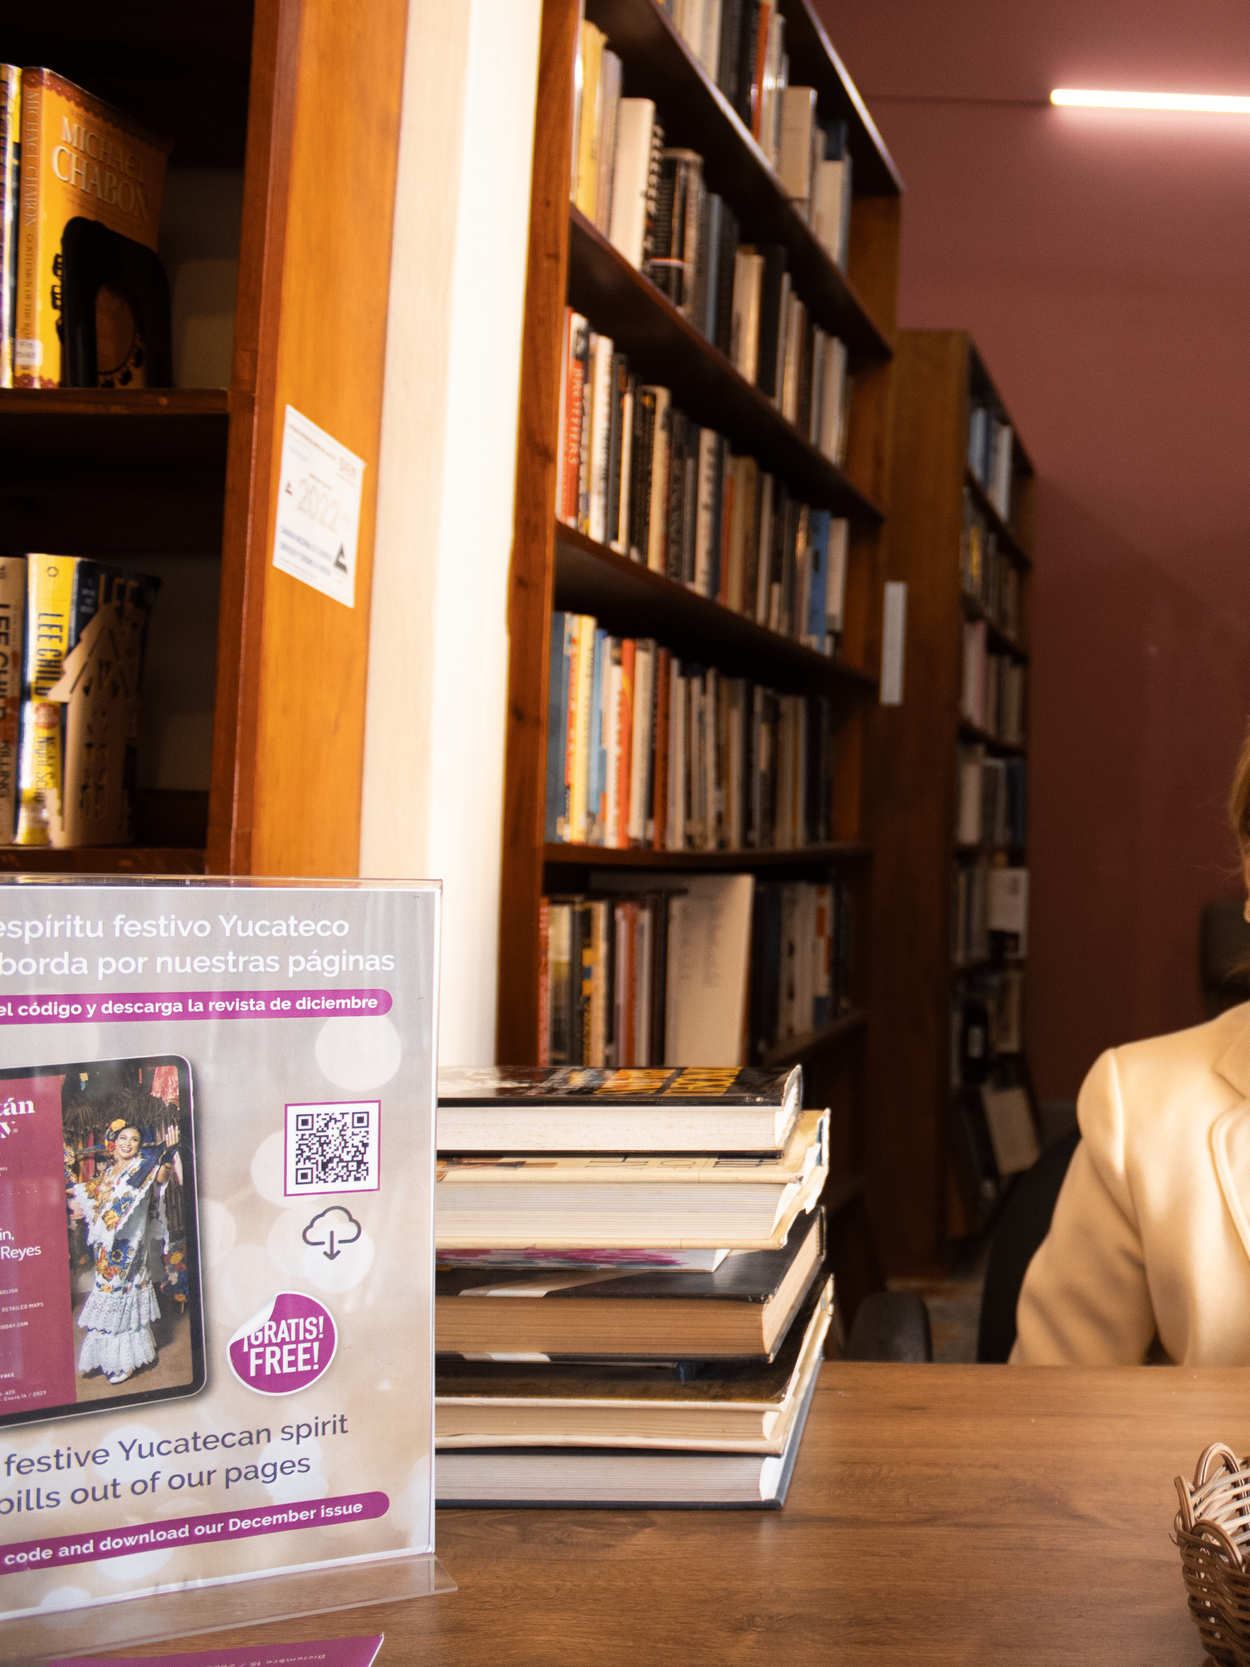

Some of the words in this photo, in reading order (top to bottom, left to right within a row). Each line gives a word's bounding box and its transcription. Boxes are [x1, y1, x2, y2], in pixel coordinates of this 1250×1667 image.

[24, 165, 38, 227] CHABON
[37, 612, 64, 644] LEE
[35, 648, 61, 697] CHILD
[113, 914, 212, 938] festivo
[218, 914, 350, 938] Yucateco
[98, 955, 148, 980] por
[155, 951, 280, 974] nuestras
[288, 949, 395, 977] páginas
[17, 1000, 82, 1019] código
[86, 1003, 97, 1018] y
[101, 998, 183, 1017] descarga
[188, 998, 204, 1013] la
[208, 996, 266, 1012] revista
[269, 996, 291, 1011] de
[295, 994, 378, 1010] diciembre
[1, 1245, 42, 1262] Reyes
[1, 1303, 29, 1313] DETAILED
[249, 1341, 320, 1377] FREE!
[4, 1446, 110, 1478] festive
[118, 1425, 272, 1462] Yucatecan
[280, 1413, 349, 1444] spirit
[70, 1479, 122, 1504] out
[130, 1471, 160, 1497] of
[167, 1470, 217, 1492] our
[224, 1454, 311, 1489] pages
[4, 1545, 53, 1566] code
[58, 1539, 95, 1558] and
[99, 1523, 190, 1552] download
[194, 1519, 224, 1536] our
[229, 1507, 317, 1533] December
[320, 1503, 364, 1518] issue
